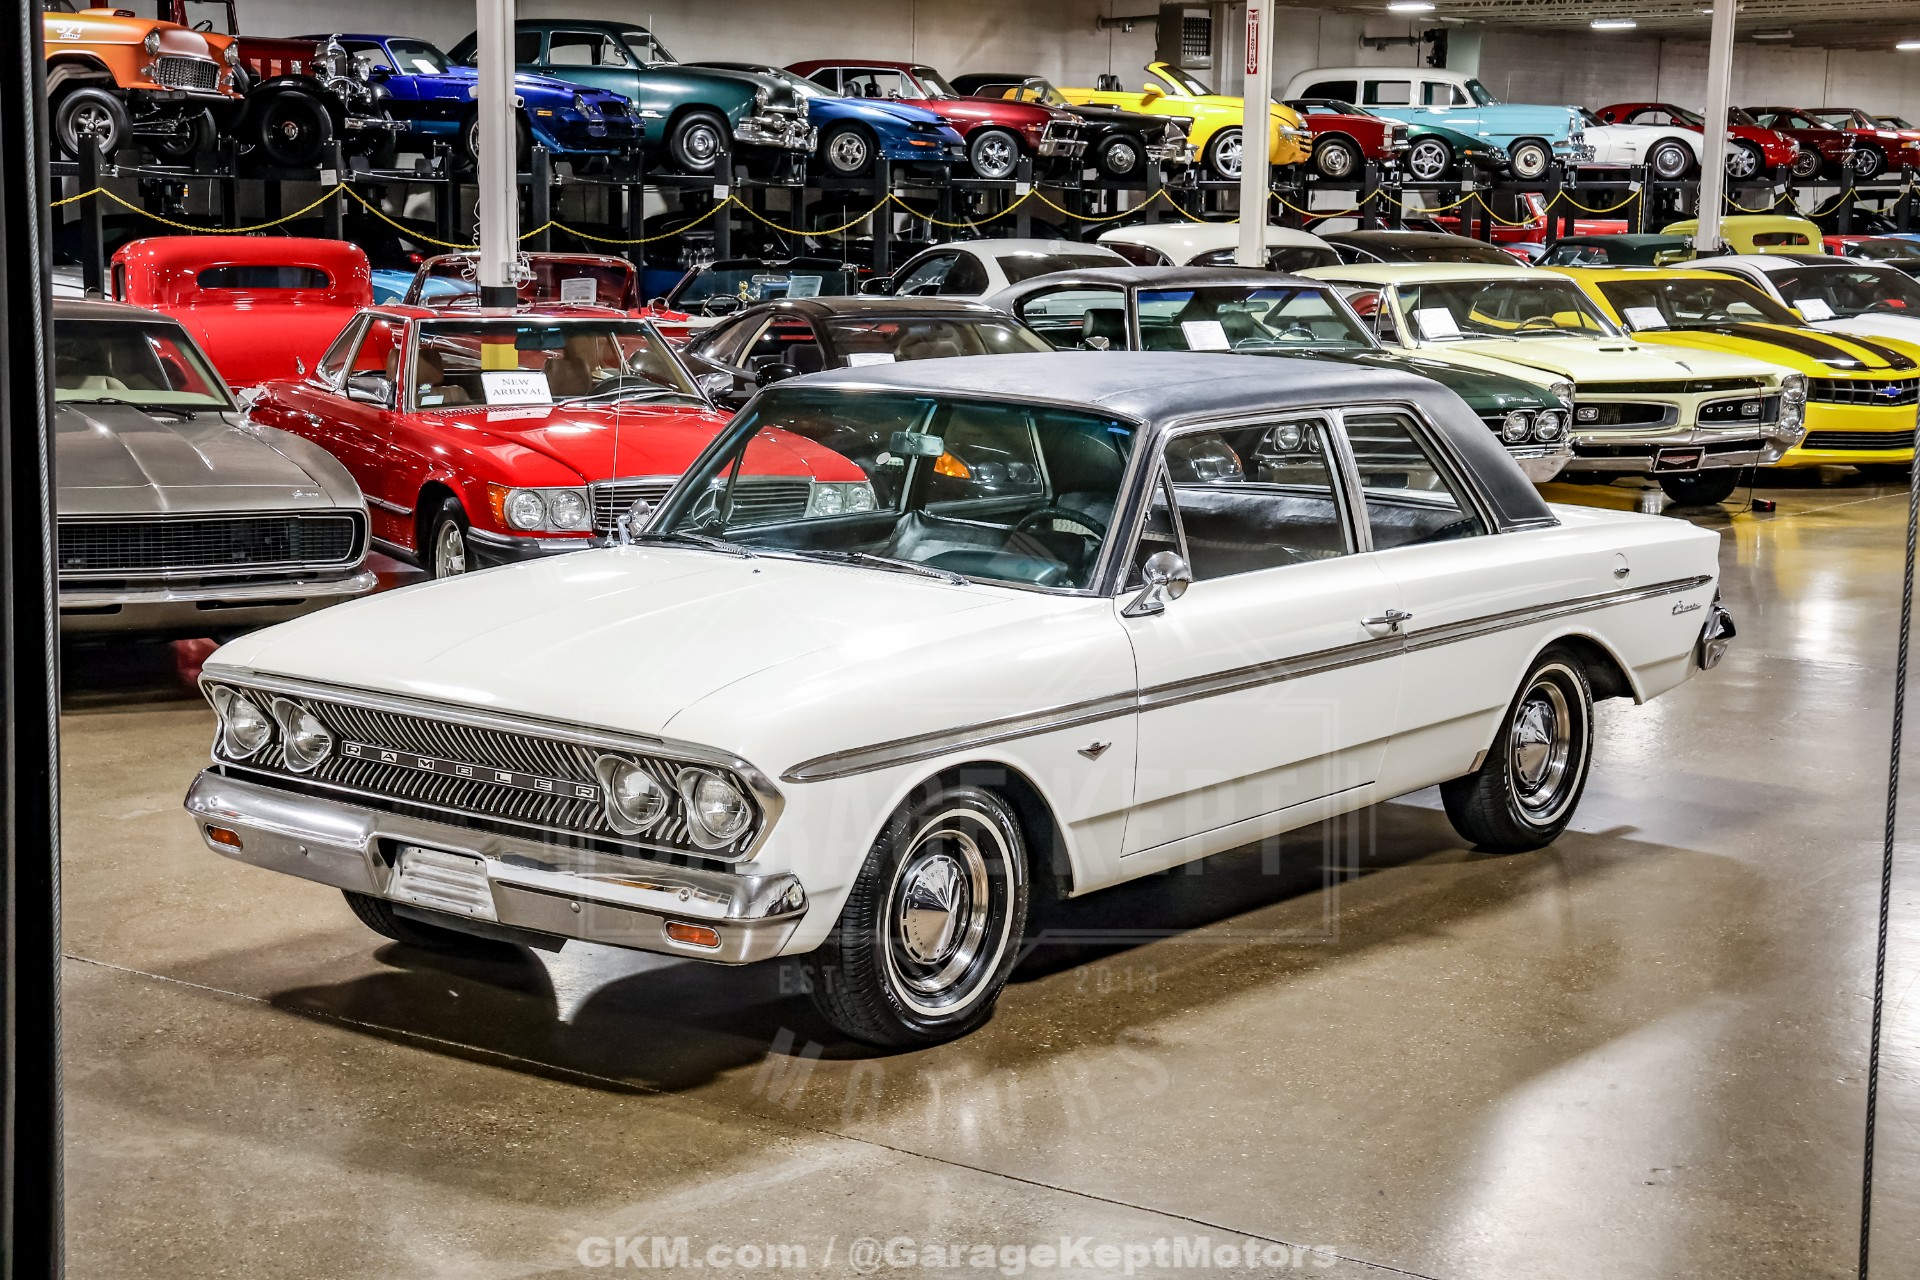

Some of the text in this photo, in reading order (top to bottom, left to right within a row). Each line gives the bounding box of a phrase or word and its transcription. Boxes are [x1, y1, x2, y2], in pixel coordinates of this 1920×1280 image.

[493, 388, 545, 396] ARRIVAL
[1706, 405, 1734, 413] GTO
[345, 743, 594, 799] RAMBLER
